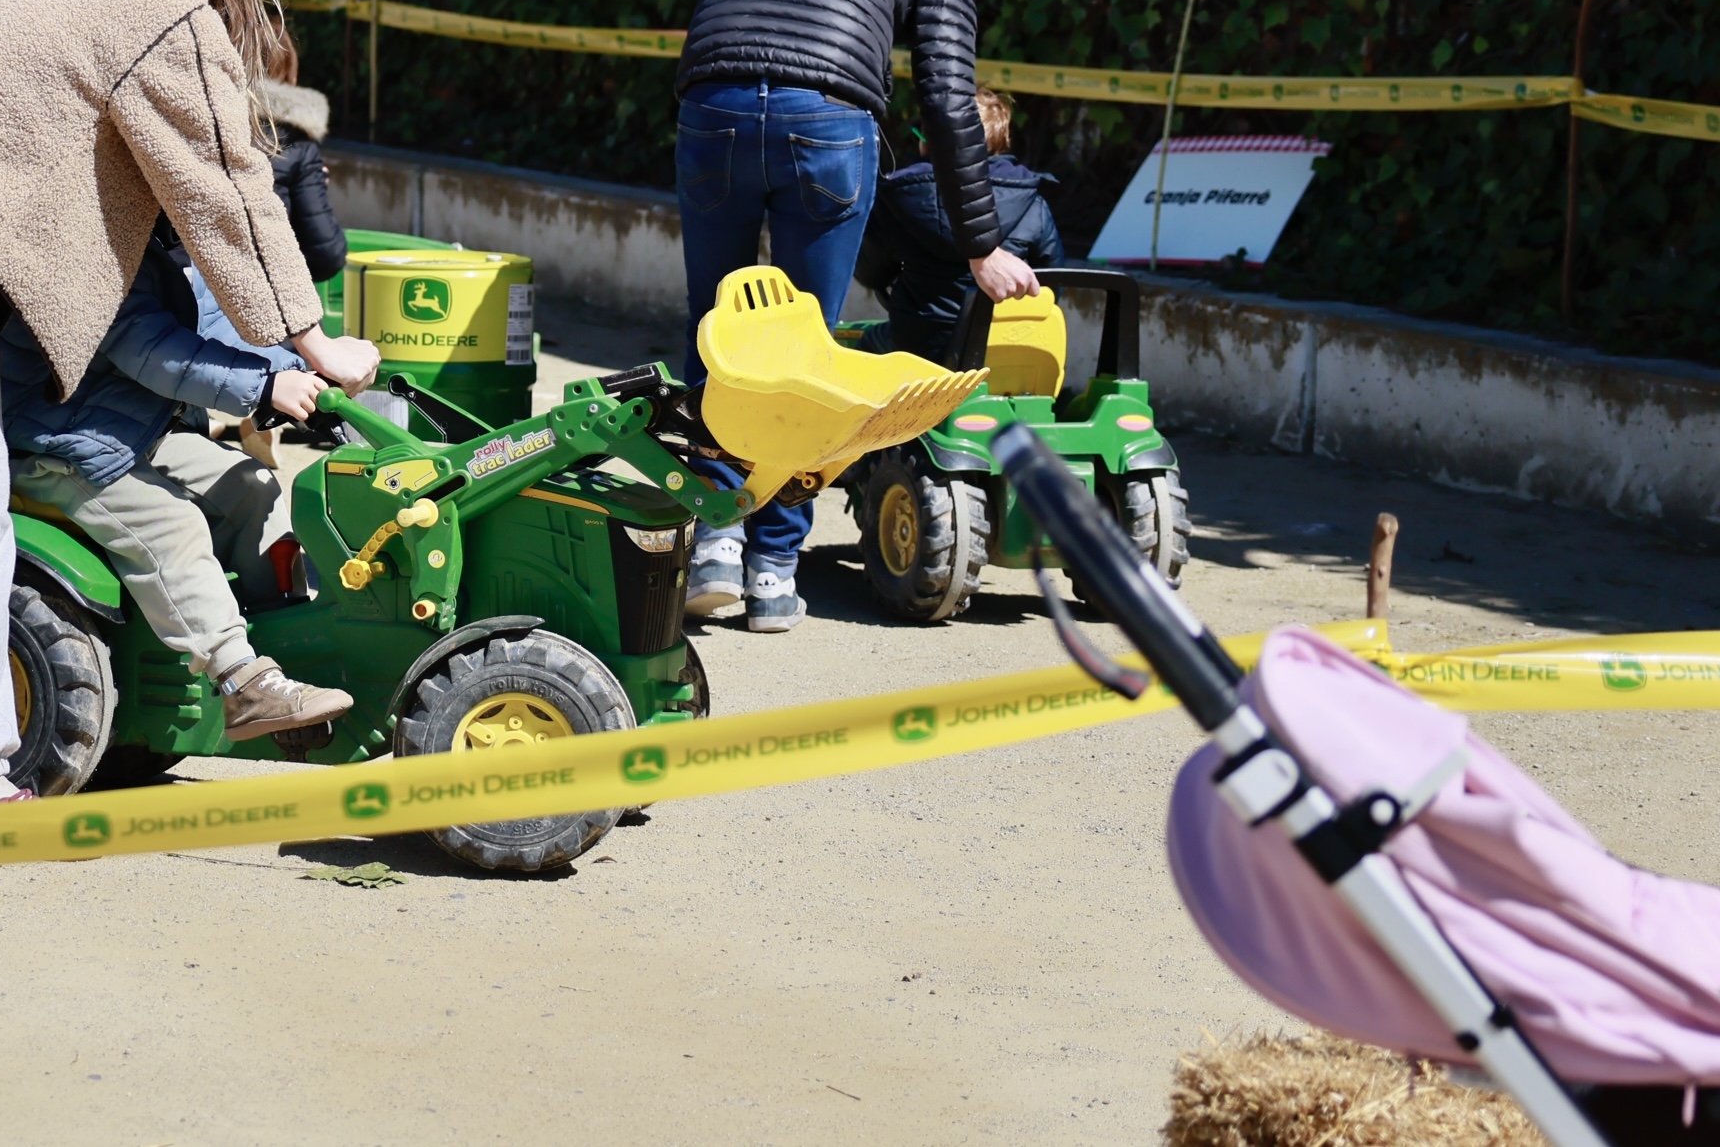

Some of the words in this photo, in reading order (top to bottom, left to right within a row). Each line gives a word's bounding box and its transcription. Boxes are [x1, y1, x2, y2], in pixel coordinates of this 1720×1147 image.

[1144, 188, 1202, 206] Ganja
[1204, 188, 1271, 206] Pifarré
[375, 330, 418, 346] JOHN
[421, 333, 478, 347] DEERE
[472, 453, 506, 475] trac
[506, 433, 551, 460] lader
[475, 440, 506, 459] rolly
[1396, 661, 1466, 682] JOHN
[1472, 660, 1560, 681] DEERE
[488, 675, 527, 692] rolly
[529, 680, 565, 704] toys
[944, 701, 1020, 727] JOHN
[1026, 685, 1118, 714] DEERE
[674, 743, 751, 769] JOHN
[758, 727, 850, 756] DEERE
[399, 780, 477, 805] JOHN
[483, 767, 576, 794] DEERE
[121, 812, 199, 836] JOHN
[204, 801, 299, 827] DEERE
